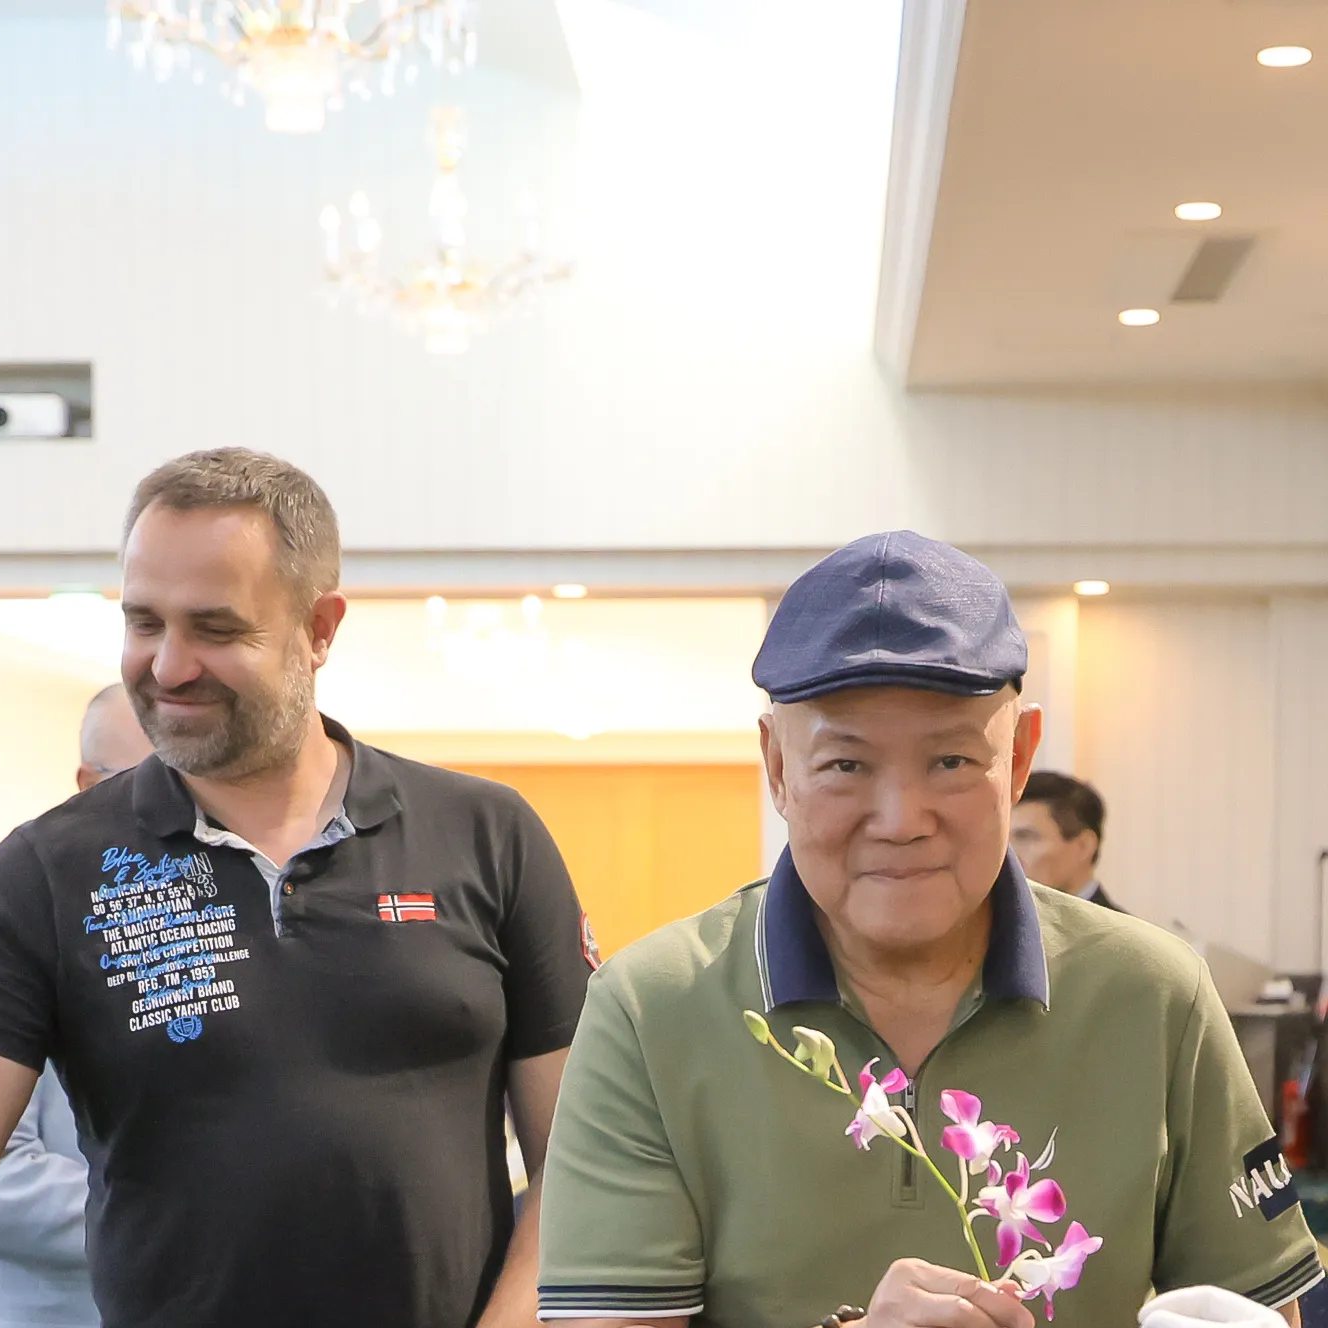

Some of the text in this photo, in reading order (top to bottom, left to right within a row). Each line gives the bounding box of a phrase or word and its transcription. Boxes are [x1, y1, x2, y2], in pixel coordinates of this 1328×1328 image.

[101, 847, 145, 872] Blue
[93, 903, 106, 915] 60
[102, 927, 122, 942] THE
[123, 916, 170, 937] NAUTICA
[111, 933, 158, 955] ATLANTIC
[160, 926, 195, 943] OCEAN
[197, 919, 236, 936] RACING
[163, 935, 233, 958] COMPETITION
[164, 972, 180, 987] TM
[190, 966, 216, 981] 1953
[197, 980, 234, 998] BRAND
[129, 995, 240, 1032] CLASSIC YACHT CLUB
